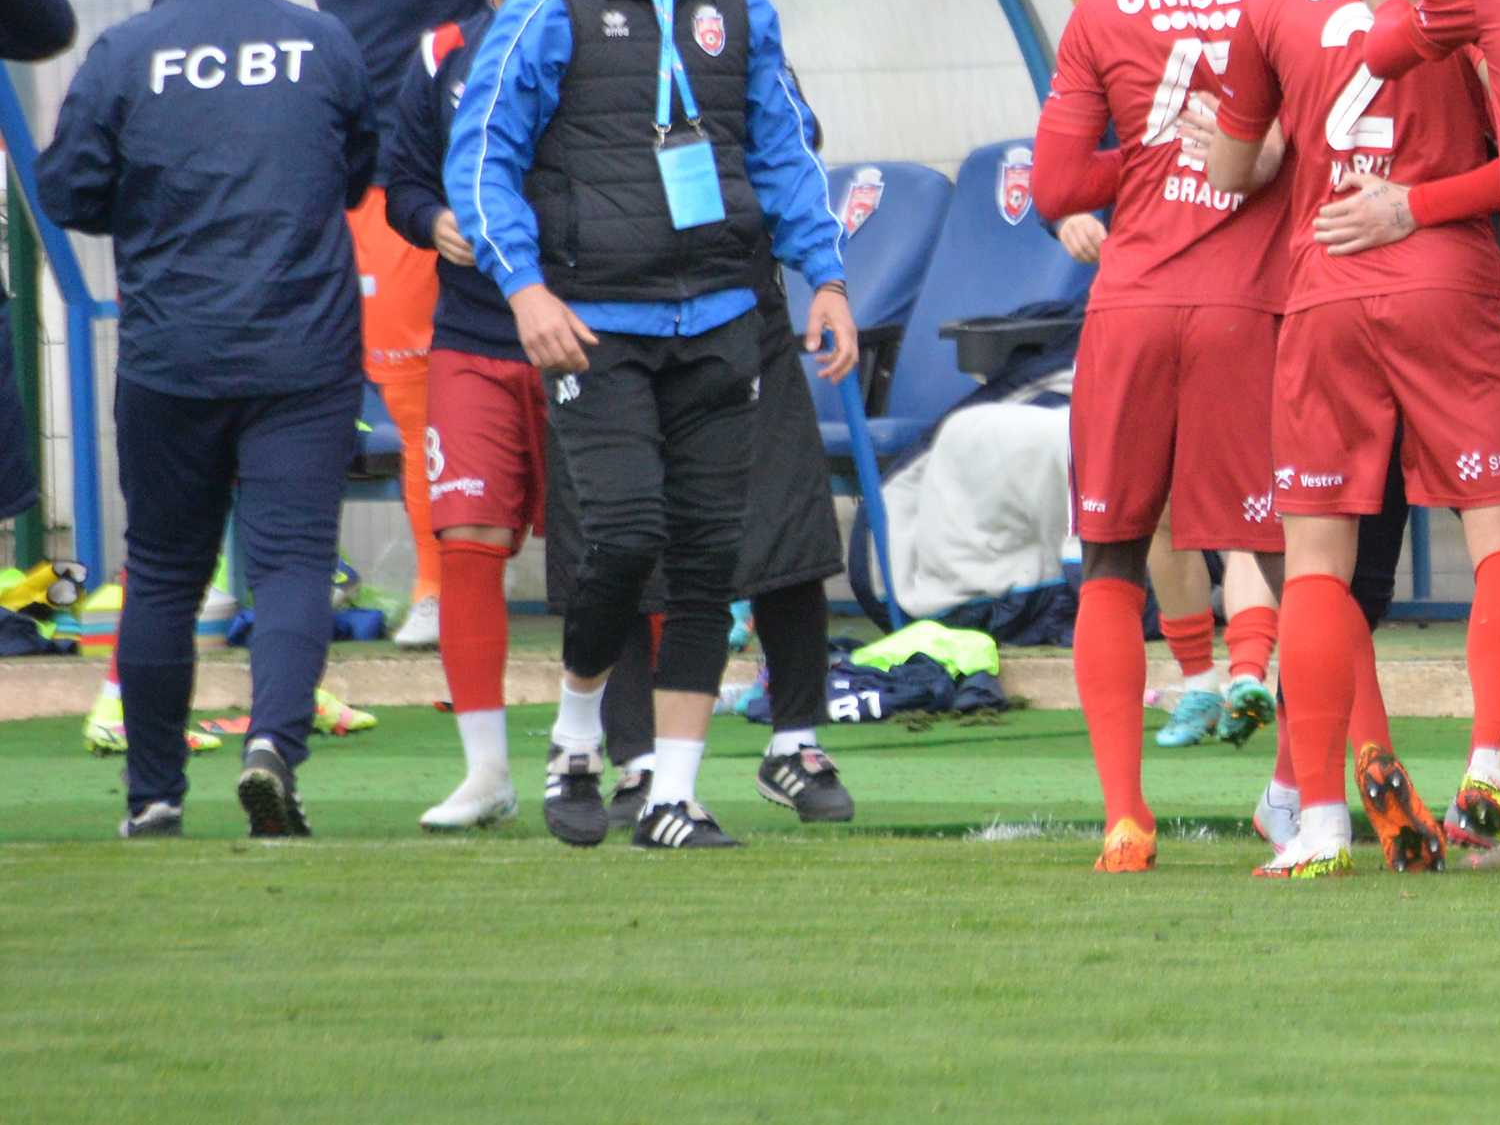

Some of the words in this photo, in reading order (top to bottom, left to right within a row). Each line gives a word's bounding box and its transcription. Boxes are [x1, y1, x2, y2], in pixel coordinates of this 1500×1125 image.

[150, 44, 227, 94] FC
[238, 40, 314, 87] BT
[1321, 2, 1395, 150] 2
[557, 374, 580, 405] AB
[1300, 474, 1343, 488] Vestra
